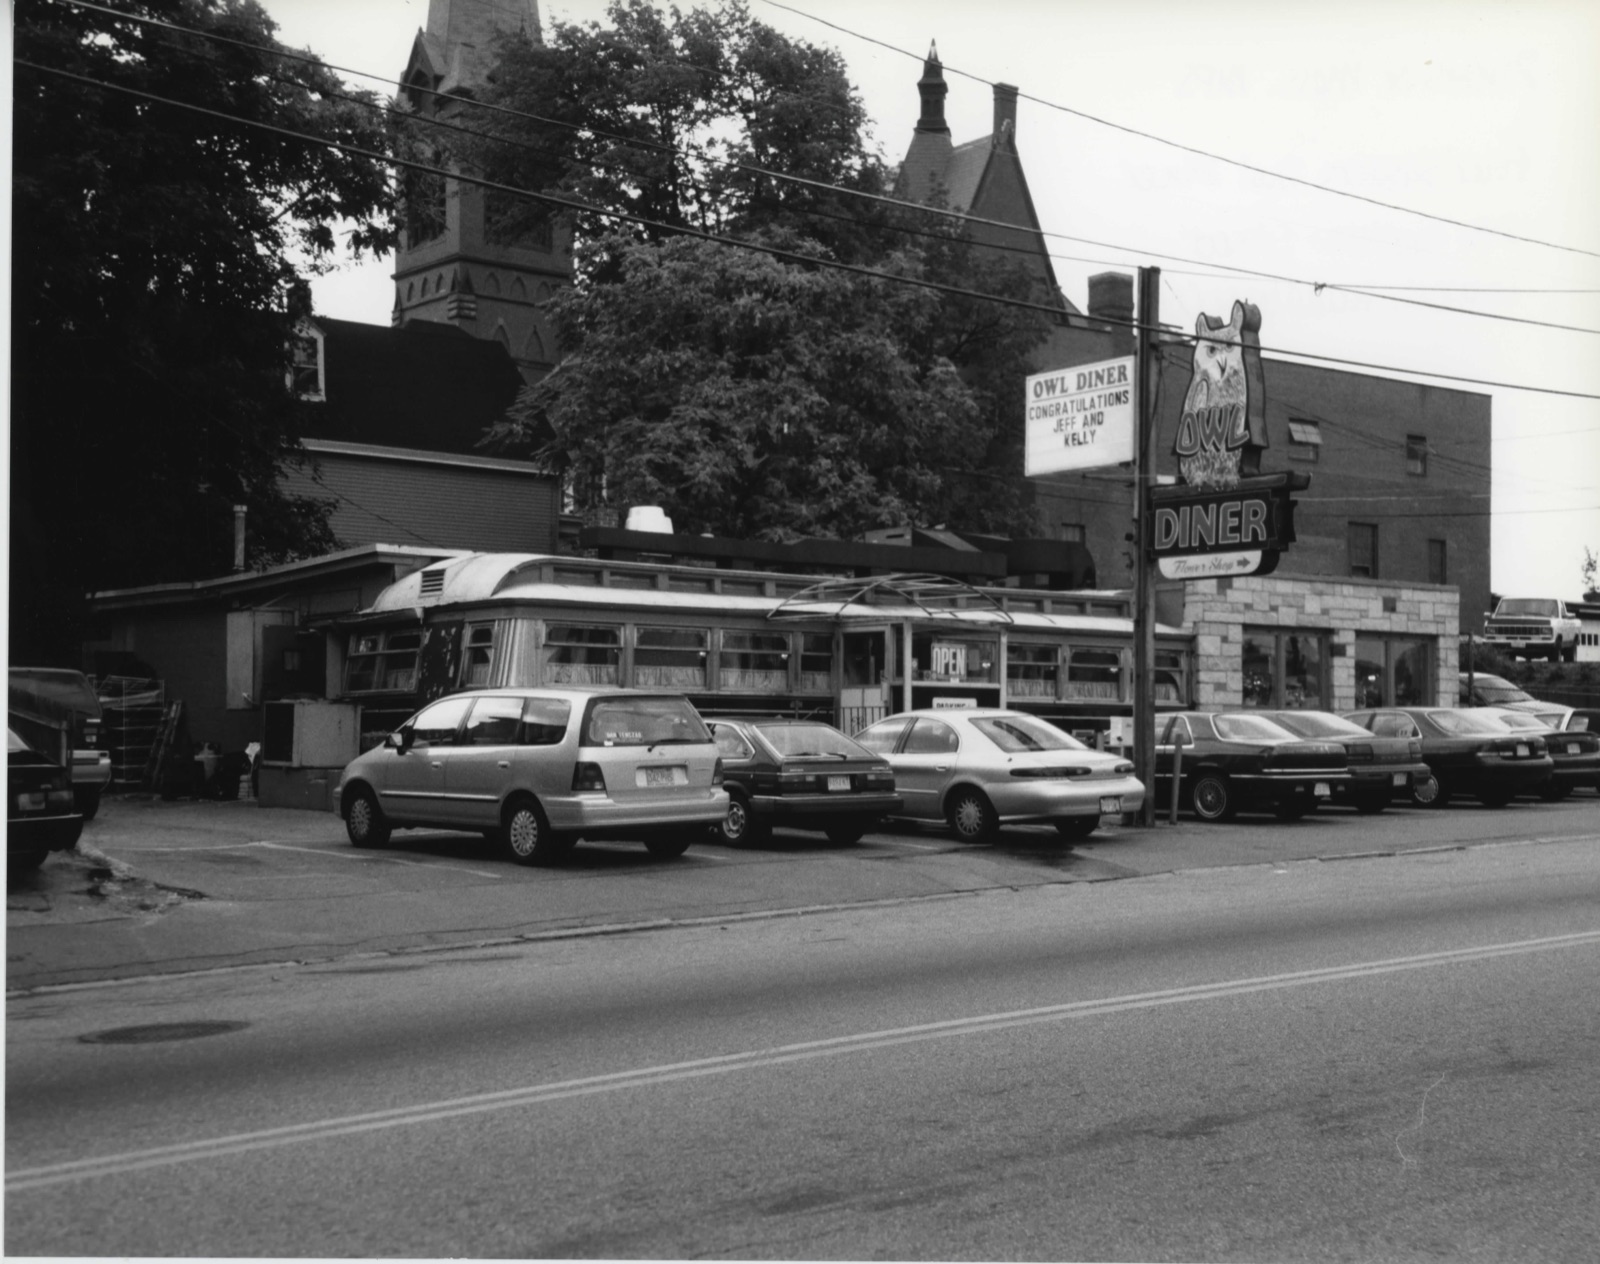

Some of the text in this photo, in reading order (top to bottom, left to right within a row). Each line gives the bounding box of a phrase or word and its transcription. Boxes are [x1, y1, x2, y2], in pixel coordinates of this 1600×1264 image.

[1033, 364, 1128, 398] OWL DINER
[1029, 390, 1129, 420] CONGRATULATIONS
[1053, 411, 1104, 433] JEFF AND
[1176, 403, 1250, 455] OWL
[1064, 429, 1096, 447] KELLY
[1154, 499, 1267, 549] DINER
[932, 647, 966, 675] OPEN
